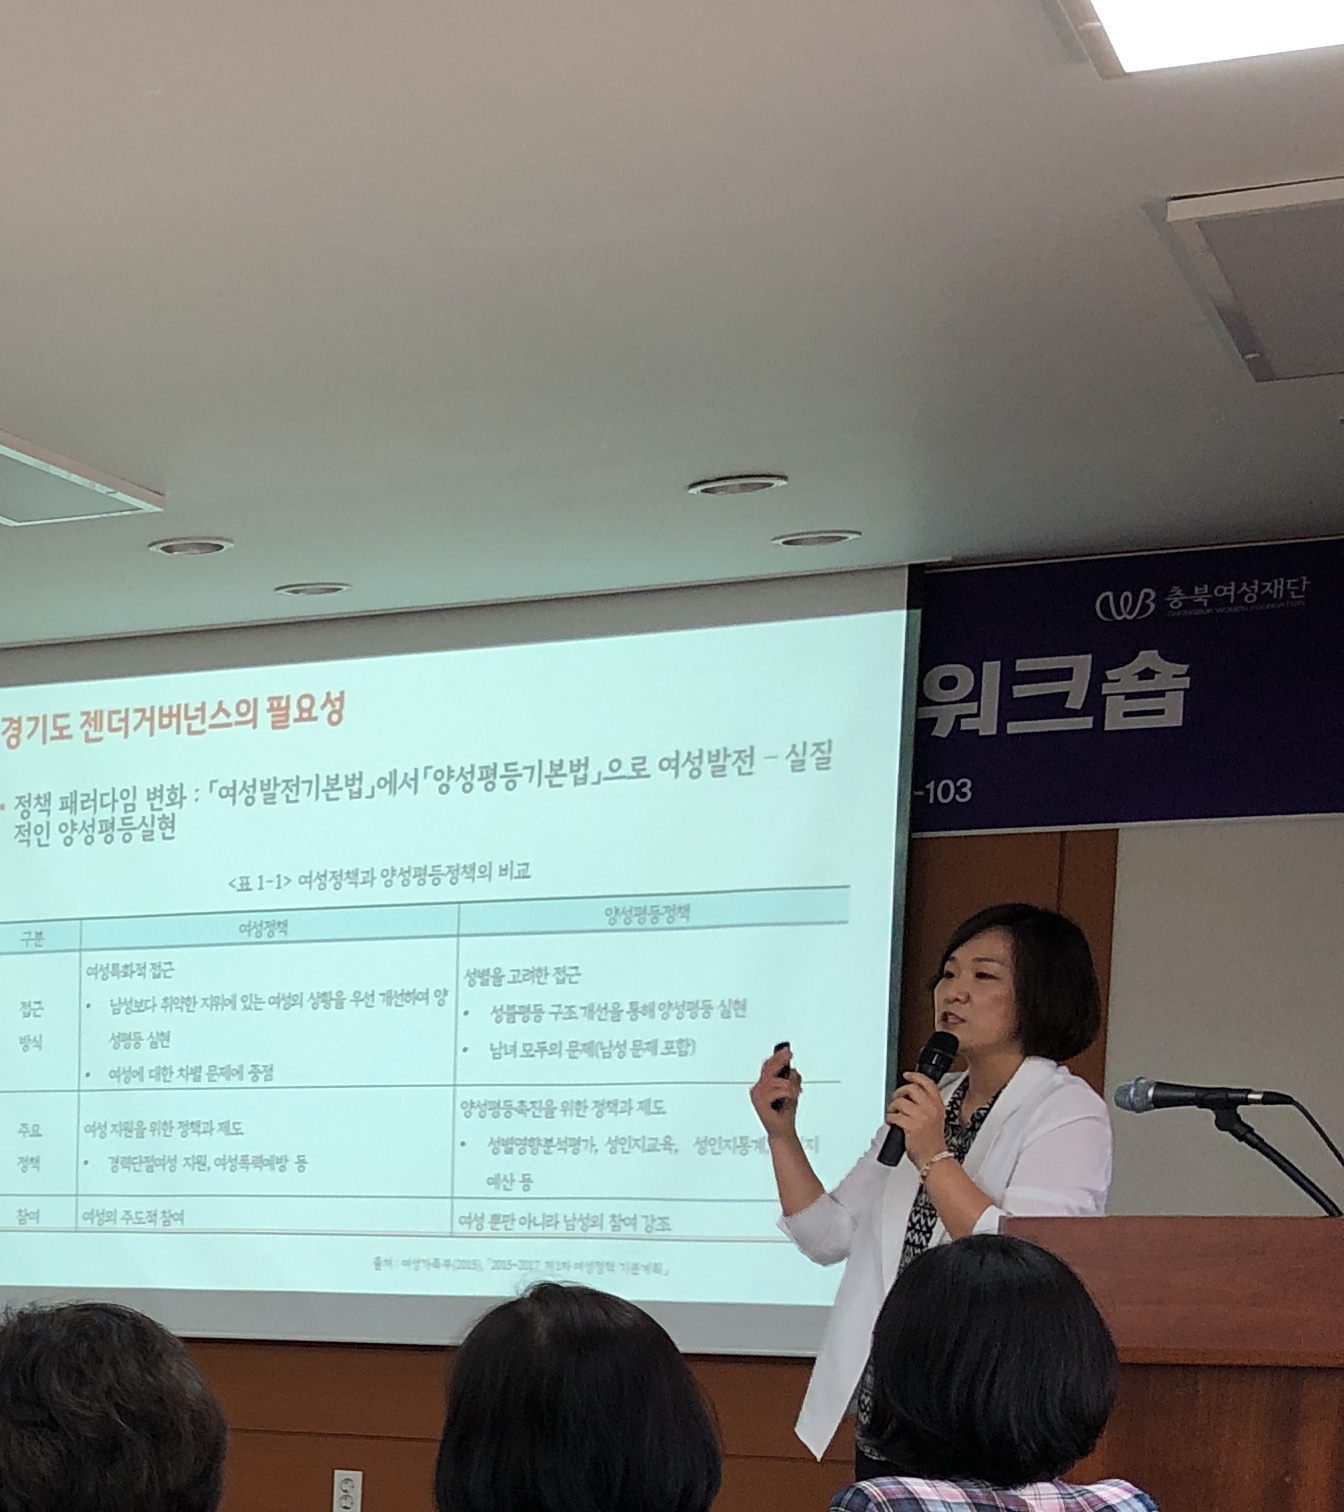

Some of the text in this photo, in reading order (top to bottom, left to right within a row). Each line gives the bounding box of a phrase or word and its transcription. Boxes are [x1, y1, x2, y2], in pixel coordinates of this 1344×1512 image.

[1164, 575, 1311, 611] 충북여성재단
[917, 648, 1191, 738] 워크숍
[0, 690, 346, 750] 경기도 젠더거버넌스의 필요성
[14, 791, 53, 821] 정책
[58, 785, 138, 816] 패러다임
[146, 782, 188, 813] 변화
[658, 744, 756, 782] 여성발전
[785, 738, 834, 773] 실질
[14, 812, 177, 849] 적인 양성평등실현
[227, 859, 532, 893] <표 1-1> 여성정책과 양성평등정책의 비교
[604, 903, 692, 926] 양성평등정책
[20, 930, 46, 948] 구분
[238, 919, 290, 939] 여성정책
[85, 960, 176, 982] 여성특화적 접근
[462, 964, 582, 988] 성별을 고려한 접근
[19, 1000, 45, 1019] 접근
[109, 987, 450, 1016] 남성보다 취약한 지위에 있는 여성의 상황을 우선 개선하여 양
[547, 1003, 579, 1022] 구조
[579, 1002, 624, 1023] 개선을
[625, 1000, 656, 1022] 통해
[657, 999, 714, 1021] 양성평등
[717, 997, 748, 1019] 실현
[19, 1033, 43, 1052] 방식
[146, 1030, 171, 1049] 실현
[489, 1040, 518, 1061] 남녀
[519, 1040, 564, 1060] 모두의
[629, 1037, 659, 1059] 문제
[660, 1037, 696, 1058] 포함)
[108, 1062, 274, 1084] 여성에 대한 차별 문제에 중점
[461, 1097, 667, 1120] 양성평등촉진을 위한 정책과 제도
[18, 1122, 42, 1138] 주요
[84, 1119, 245, 1140] 여성 지원을 위한 정책과 제도
[17, 1155, 41, 1174] 정책
[107, 1153, 178, 1174] 경력단절여성
[294, 1155, 308, 1173] 등
[486, 1172, 534, 1193] 예산 등
[15, 1208, 41, 1226] 참여
[81, 1208, 185, 1227] 여성의 주도적 참여
[458, 1212, 672, 1234] 여성 뿐만 아니라 남성의 참여 강조
